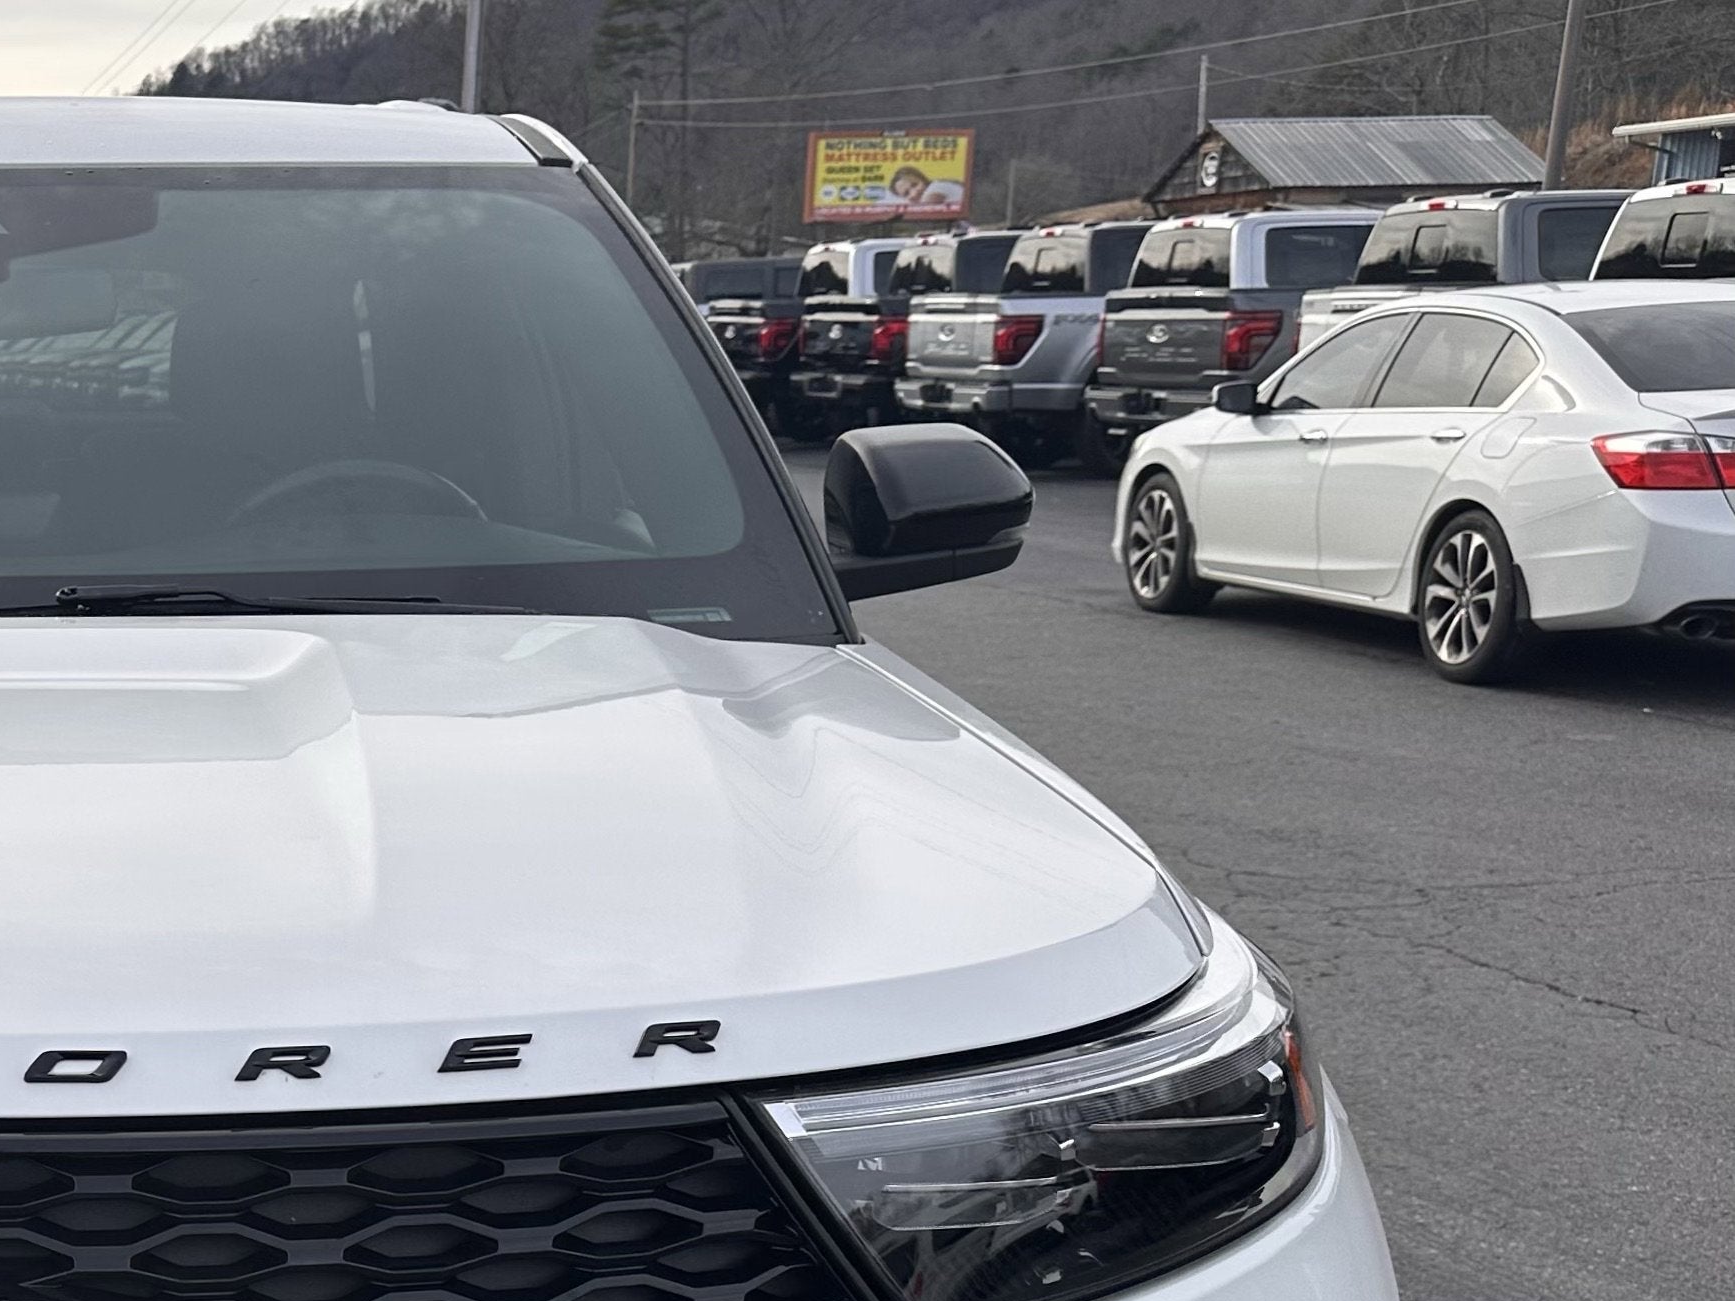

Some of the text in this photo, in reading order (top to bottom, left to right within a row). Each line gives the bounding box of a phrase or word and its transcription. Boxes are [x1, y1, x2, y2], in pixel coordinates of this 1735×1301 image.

[825, 138, 958, 150] NOTHING BUT BEDS
[824, 150, 956, 162] MATTRESS OUTLET
